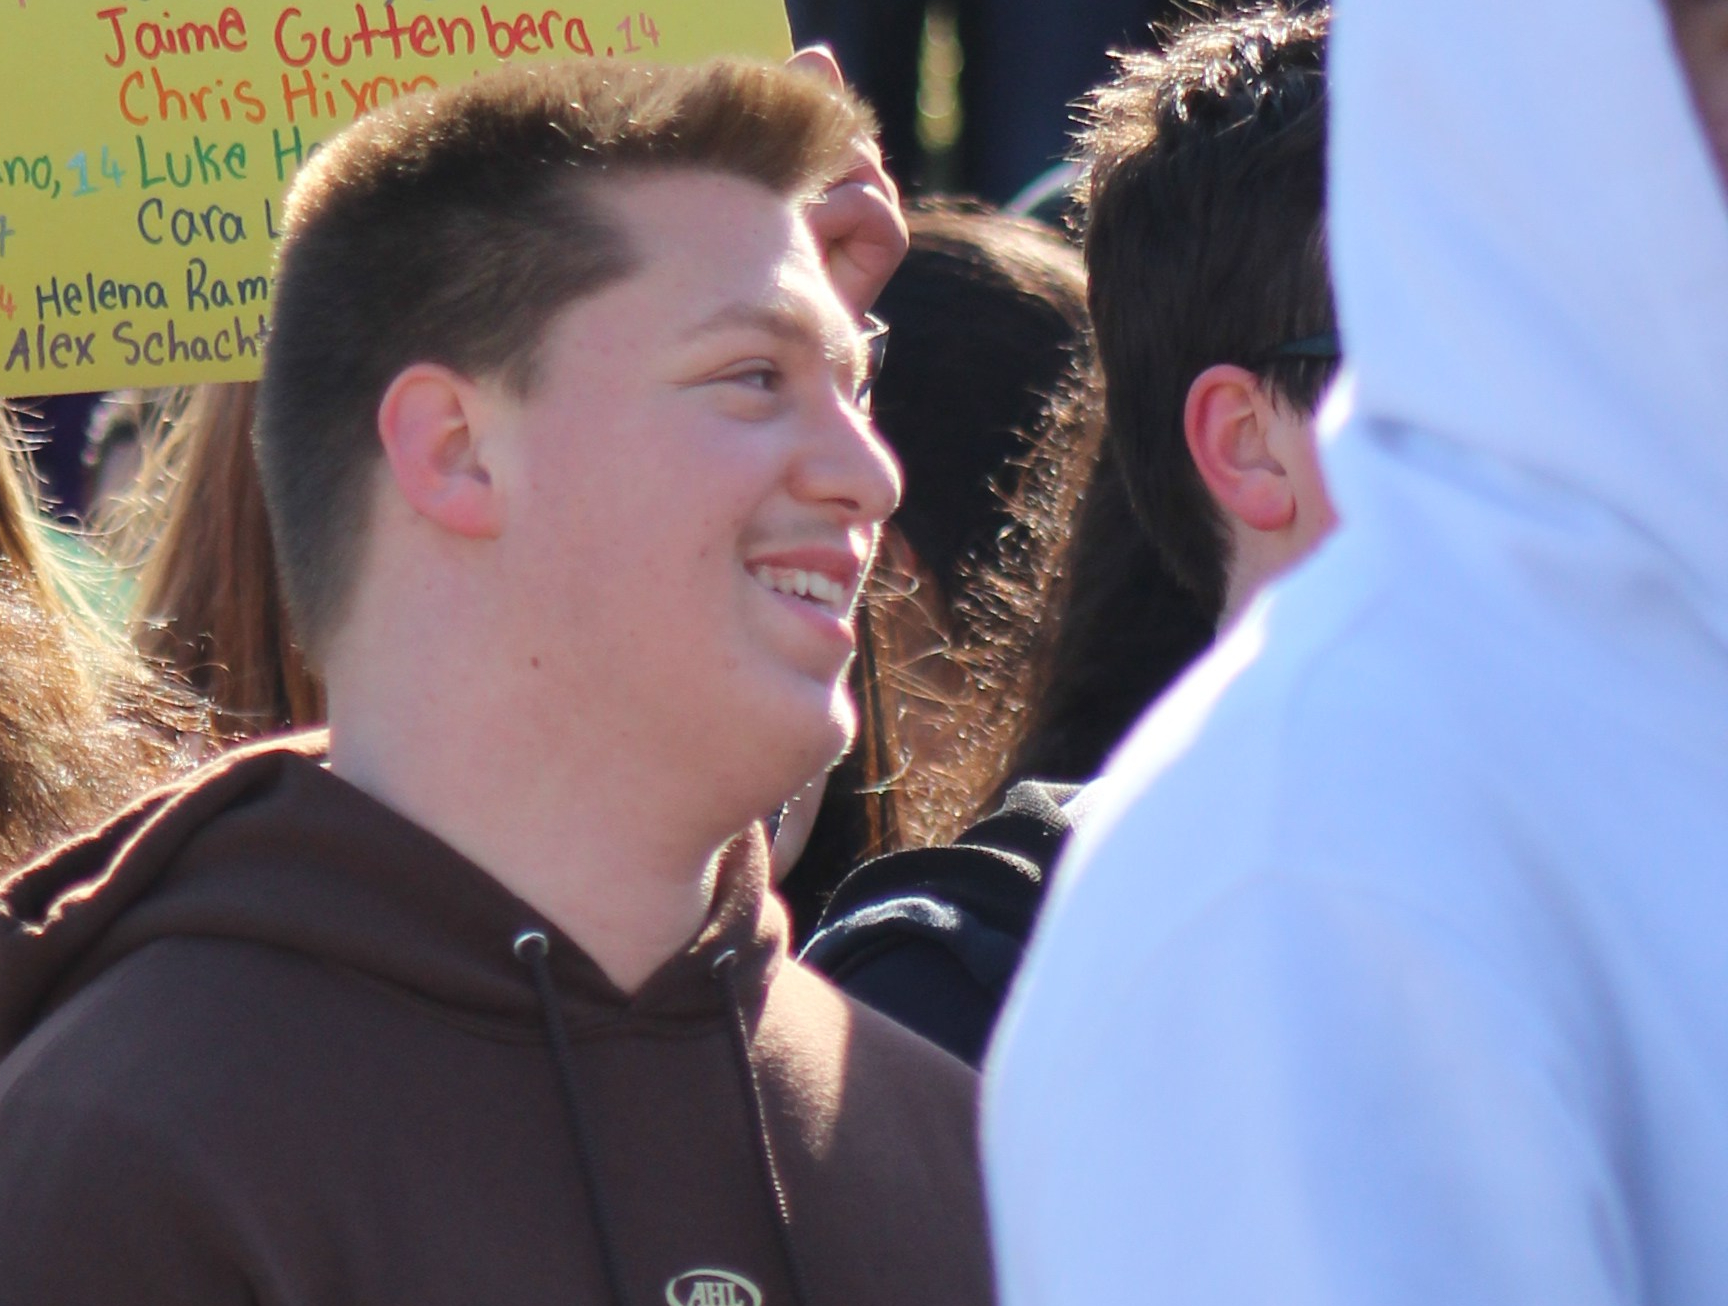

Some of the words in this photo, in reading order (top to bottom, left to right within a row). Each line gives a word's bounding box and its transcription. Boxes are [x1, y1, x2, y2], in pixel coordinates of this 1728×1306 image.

[96, 4, 248, 68] Jaime
[616, 12, 661, 53] 14
[118, 67, 266, 126] Chris
[65, 144, 126, 196] 14
[135, 134, 248, 188] Luke
[137, 197, 247, 245] Cara
[36, 273, 168, 320] Helena
[187, 257, 276, 311] Ram
[4, 323, 95, 373] Alex
